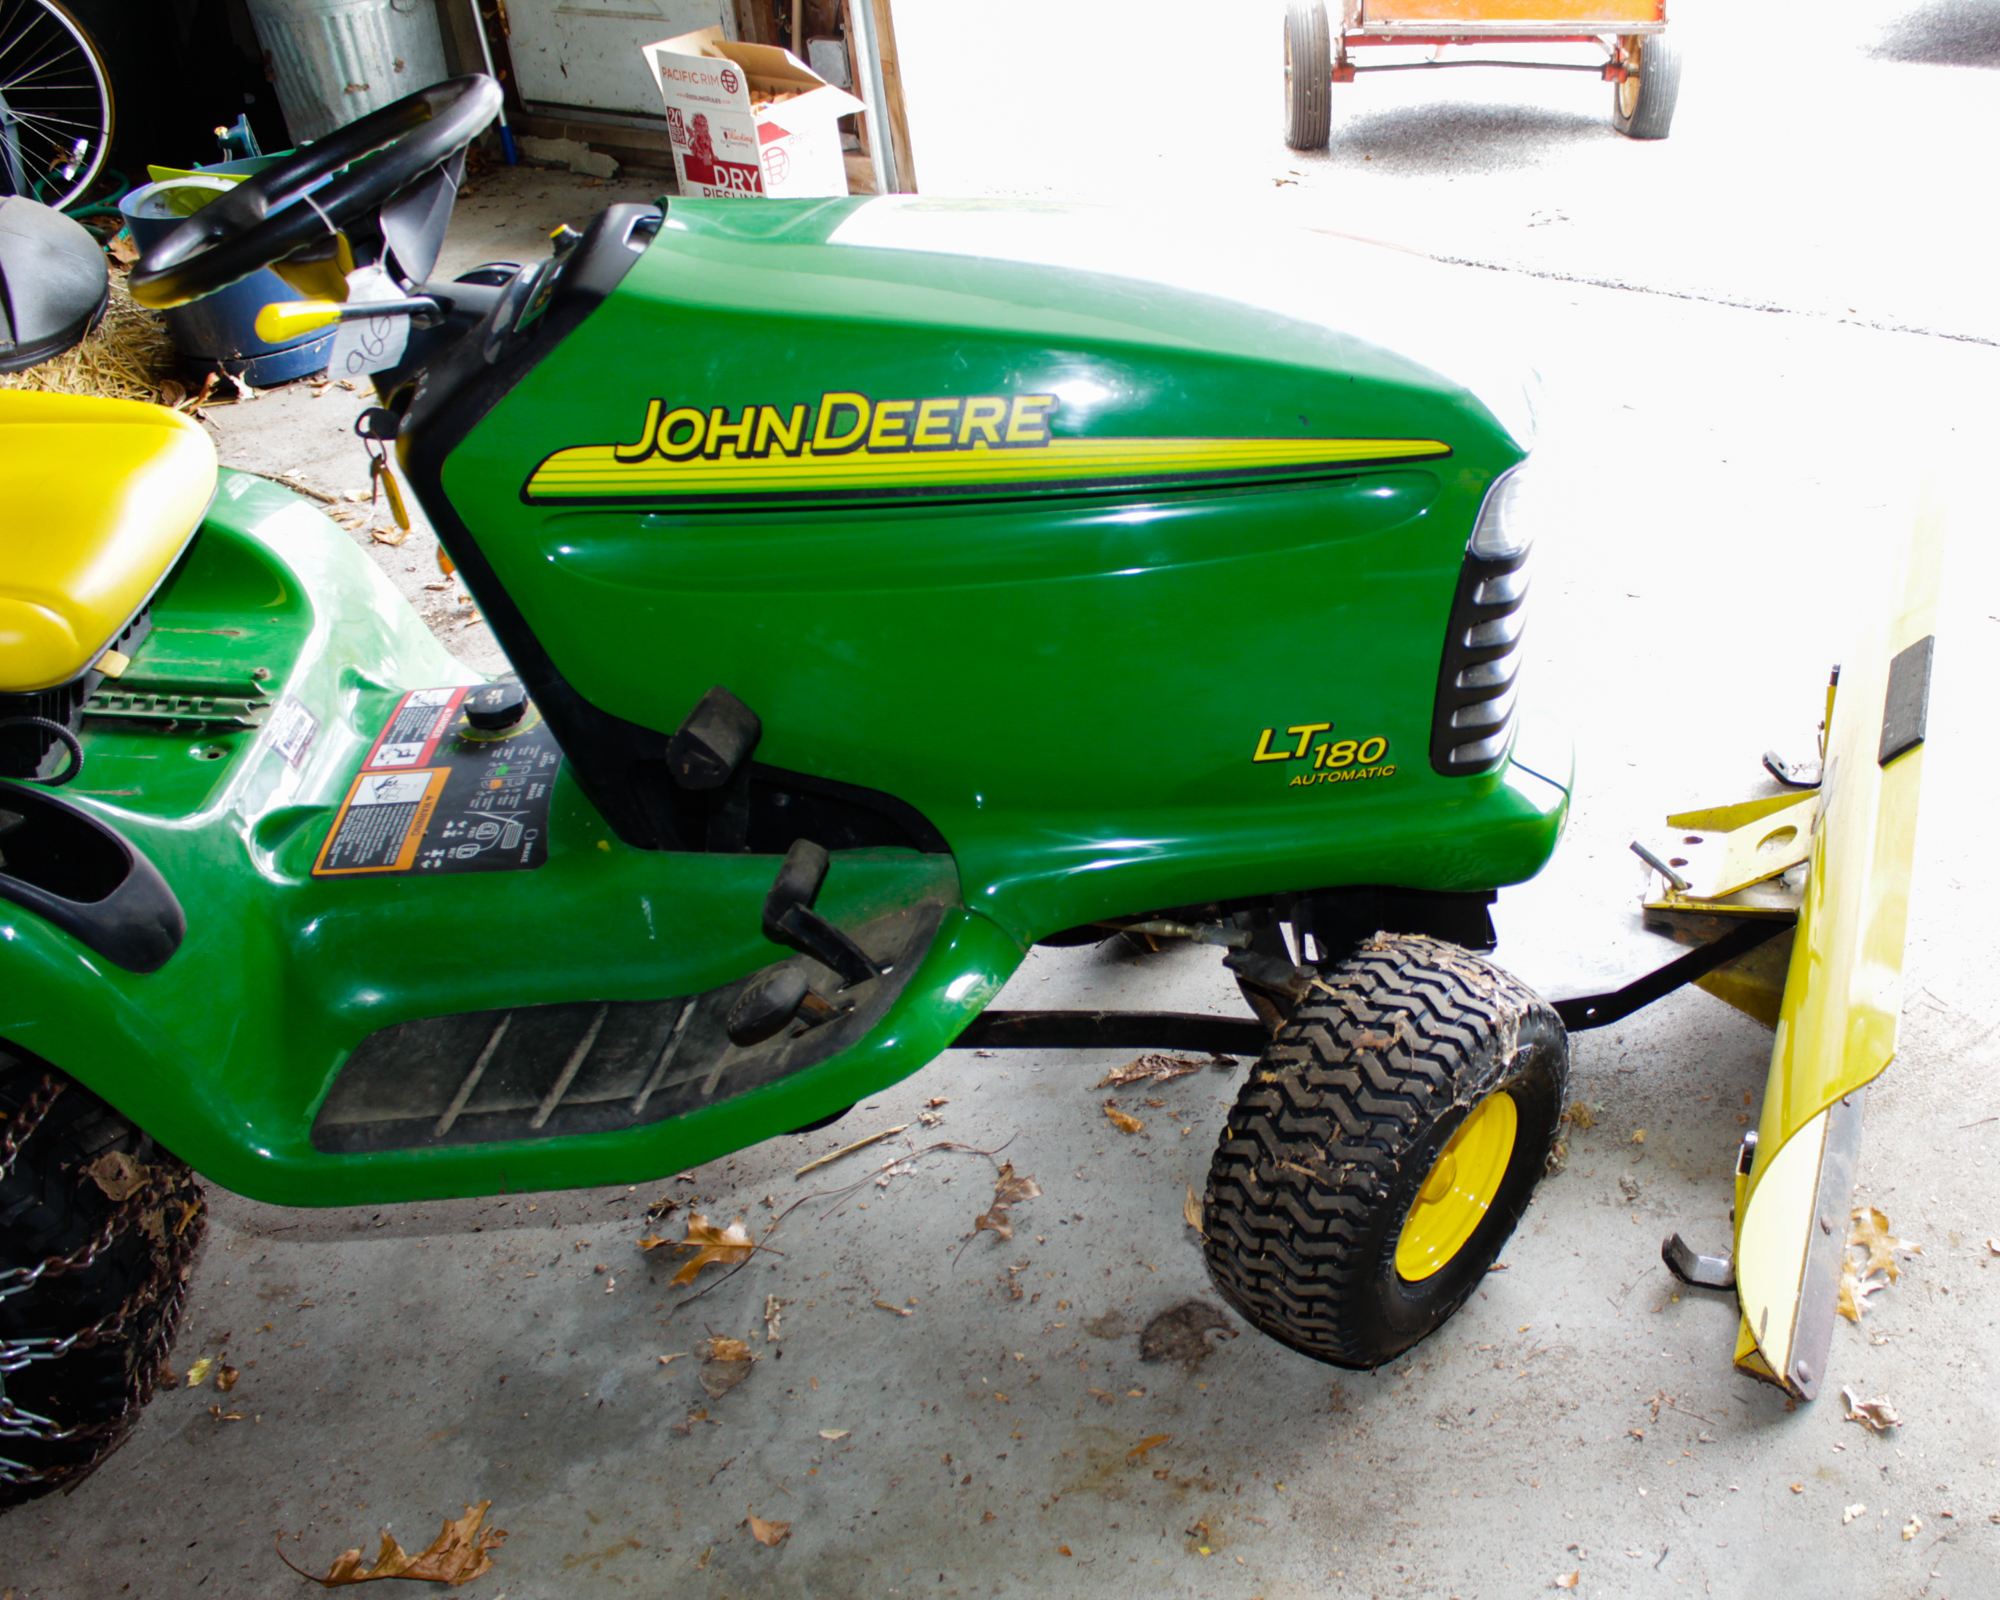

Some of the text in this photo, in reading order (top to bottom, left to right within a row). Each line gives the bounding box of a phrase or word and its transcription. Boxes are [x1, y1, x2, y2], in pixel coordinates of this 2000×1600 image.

[662, 67, 720, 87] PACIFIC RIM
[668, 107, 681, 127] 20
[713, 165, 758, 193] DRY
[615, 391, 1058, 462] JOHN DEERE
[431, 713, 452, 738] DANGER
[539, 752, 550, 768] LATCH
[1288, 765, 1396, 787] AUTOMATIC
[526, 783, 538, 800] BRAKE
[535, 783, 546, 798] PARK
[410, 802, 434, 836] WARNING
[520, 842, 533, 863] BRAKE
